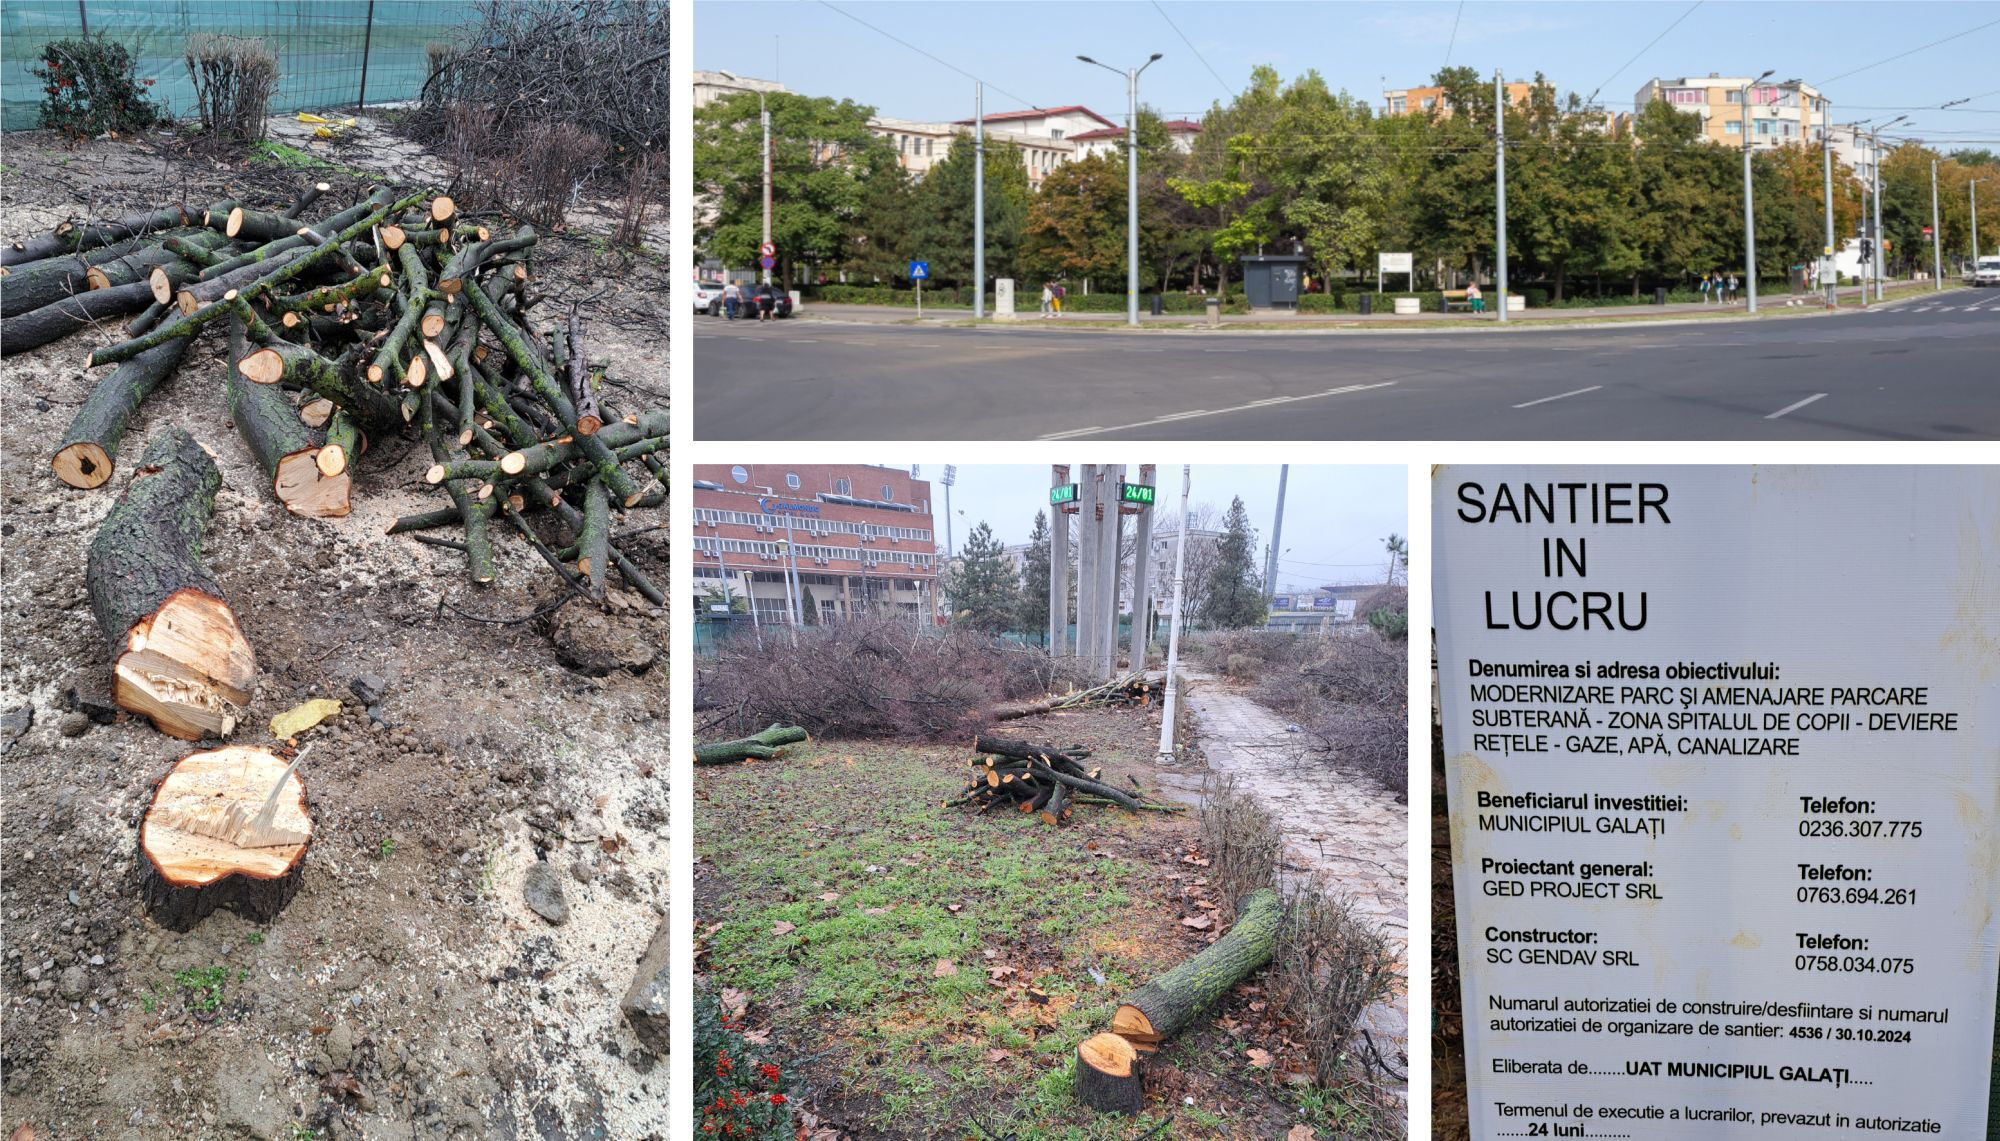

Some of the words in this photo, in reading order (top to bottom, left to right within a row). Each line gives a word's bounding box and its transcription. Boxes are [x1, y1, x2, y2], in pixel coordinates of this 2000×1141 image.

[1457, 482, 1671, 524] SANTIER
[1544, 538, 1586, 578] IN
[1485, 591, 1647, 631] LUCRU
[1469, 659, 1569, 678] Denumirea
[1575, 661, 1591, 678] si
[1597, 661, 1660, 679] adresa
[1666, 662, 1779, 680] obiectivului:
[1471, 684, 1615, 704] MODERNIZARE
[1621, 687, 1674, 705] PARC
[1702, 688, 1824, 705] AMENAJARE
[1831, 687, 1928, 705] PARCARE
[1473, 707, 1591, 728] SUBTERANĂ
[1608, 712, 1663, 729] ZONA
[1668, 712, 1758, 730] SPITALUL
[1764, 713, 1790, 730] DE
[1797, 713, 1849, 731] COPII
[1869, 713, 1958, 731] DEVIERE
[1566, 735, 1623, 756] GAZE,
[1628, 733, 1671, 757] APĂ,
[1678, 737, 1800, 755] CANALIZARE
[1477, 791, 1588, 810] Beneficiarul
[1595, 793, 1687, 811] investitiei:
[1800, 796, 1875, 813] Telefon:
[1479, 815, 1591, 833] MUNICIPIUL
[1799, 820, 1922, 838] 0236.307.775
[1482, 858, 1575, 876] Proiectant
[1580, 861, 1653, 880] general:
[1798, 864, 1872, 881] Telefon:
[1483, 880, 1524, 896] GED
[1531, 881, 1620, 898] PROJECT
[1626, 883, 1663, 899] SRL
[1797, 887, 1915, 905] 0763.694.261
[1485, 926, 1597, 944] Constructor:
[1796, 933, 1868, 950] Telefon:
[1487, 948, 1513, 964] SC
[1519, 949, 1597, 965] GENDAV
[1603, 950, 1639, 966] SRL
[1795, 955, 1914, 974] 0758.034.075
[1489, 995, 1558, 1011] Numarul
[1564, 997, 1650, 1013] autorizatiei
[1656, 998, 1677, 1013] de
[1682, 1001, 1853, 1019] construire/desfiintare
[1859, 1005, 1872, 1020] si
[1878, 1008, 1948, 1023] numarul
[1490, 1017, 1576, 1032] autorizatiei
[1582, 1018, 1602, 1032] de
[1608, 1019, 1693, 1037] organizare
[1699, 1021, 1719, 1035] de
[1725, 1022, 1783, 1038] santier:
[1789, 1026, 1823, 1039] 4536
[1836, 1028, 1911, 1043] 30.10.2024
[1493, 1059, 1562, 1074] Eliberata
[1668, 1062, 1774, 1080] MUNICIPIUL
[1494, 1102, 1567, 1117] Termenul
[1573, 1104, 1593, 1118] de
[1599, 1105, 1664, 1119] executie
[1670, 1109, 1679, 1119] a
[1685, 1106, 1754, 1124] lucrarilor,
[1761, 1112, 1831, 1126] prevazut
[1836, 1113, 1849, 1128] in
[1856, 1116, 1941, 1133] autorizatie
